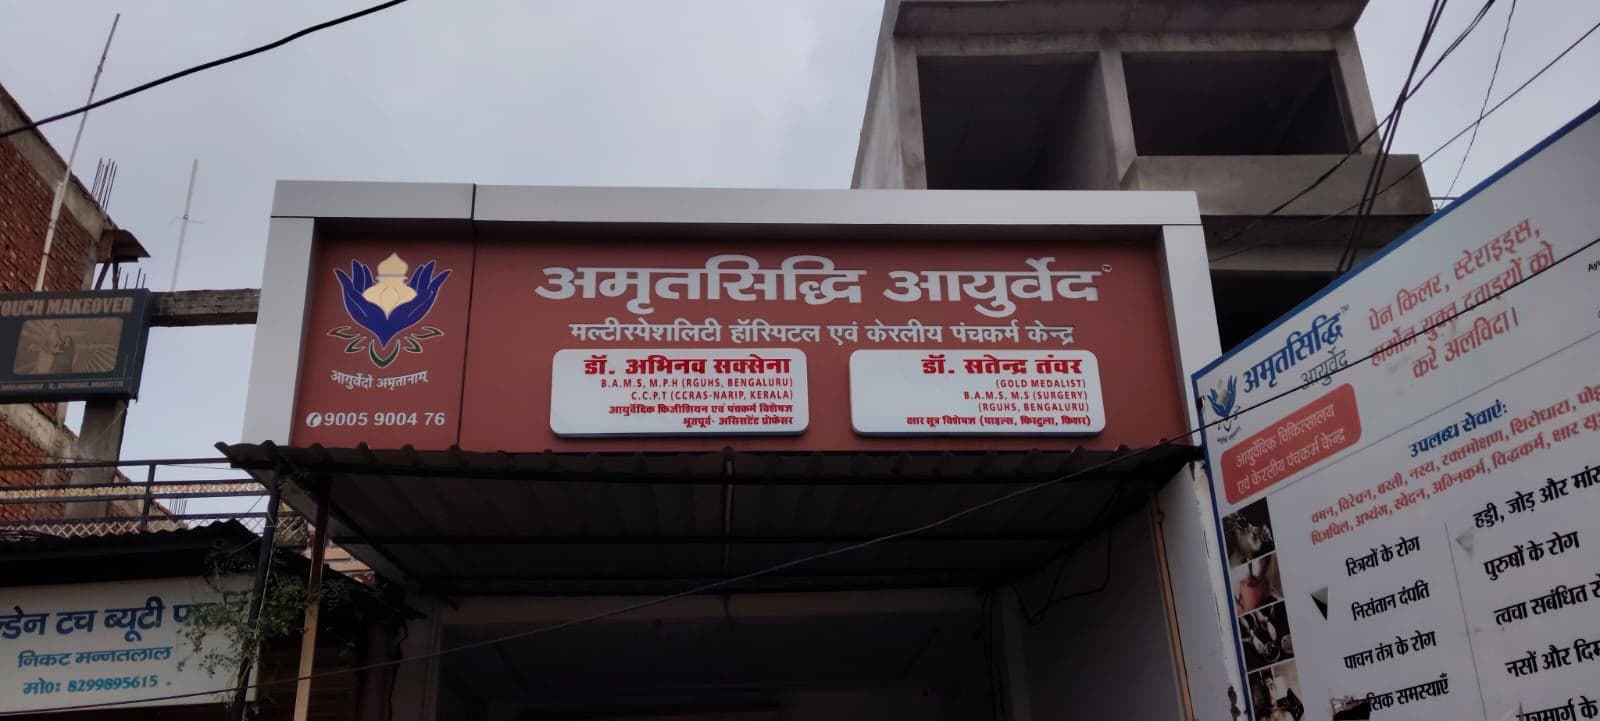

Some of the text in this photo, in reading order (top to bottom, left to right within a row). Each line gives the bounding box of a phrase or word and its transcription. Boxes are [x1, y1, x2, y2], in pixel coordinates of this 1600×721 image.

[534, 254, 1103, 318] अमृतसिद्धि आयुर्वेद
[1423, 302, 1458, 341] युक्त
[1529, 241, 1556, 274] को
[0, 296, 134, 317] OUCH MAKEOVER
[1368, 304, 1394, 330] पेन
[1396, 273, 1450, 315] किलर,
[568, 317, 1075, 345] मल्टीस्पेशलिटी हॉस्पिटल एवं केरलीय पंचकर्म केन्द्र
[584, 354, 792, 375] डॉ. अभिनव सक्सेना
[921, 354, 1083, 375] डॉ. सतेन्द्र तंवर
[1243, 313, 1344, 393] अमृतसिद्धि
[330, 370, 429, 390] आयुर्वेदो अमृतानाम्
[1300, 346, 1349, 390] आयुर्वेद
[631, 391, 667, 401] C.C.P.T
[750, 391, 793, 401] KERALA)
[650, 378, 678, 388] M.P.H
[727, 377, 793, 388] BENGALURU)
[995, 379, 1086, 389] (GOLD MEDALIST)
[1032, 391, 1088, 401] (SURGERY)
[324, 411, 446, 426] 9005 9004 76
[609, 403, 655, 416] आयुर्वेदिक
[711, 403, 725, 414] एवं
[1023, 403, 1089, 413] BENGALURU)
[1235, 435, 1277, 468] आयुर्वेदिक
[1277, 404, 1336, 443] चिकित्सालय
[1408, 422, 1461, 458] उपलब्ध
[1552, 422, 1580, 444] क्षार
[1237, 428, 1346, 494] एवं केरलीय पंचकर्म केन्द्र
[1505, 491, 1536, 513] जोड़
[1539, 478, 1569, 503] और
[1345, 535, 1421, 576] स्त्रियों के रोग
[1483, 531, 1580, 581] पुरुषों के रोग
[1351, 579, 1431, 621] निसंतान दंपति
[1493, 601, 1529, 625] त्वचा
[56, 609, 98, 634] टच
[104, 596, 166, 642] ब्यूटी
[18, 646, 173, 668] निकट मन्नतलाल
[1344, 630, 1437, 670] पाचन तंत्र के रोग
[1504, 651, 1538, 677] नसों
[1541, 645, 1571, 669] और
[67, 675, 159, 693] 8299895615
[1396, 673, 1450, 705] समस्याएँ
[1578, 695, 1599, 719] के
